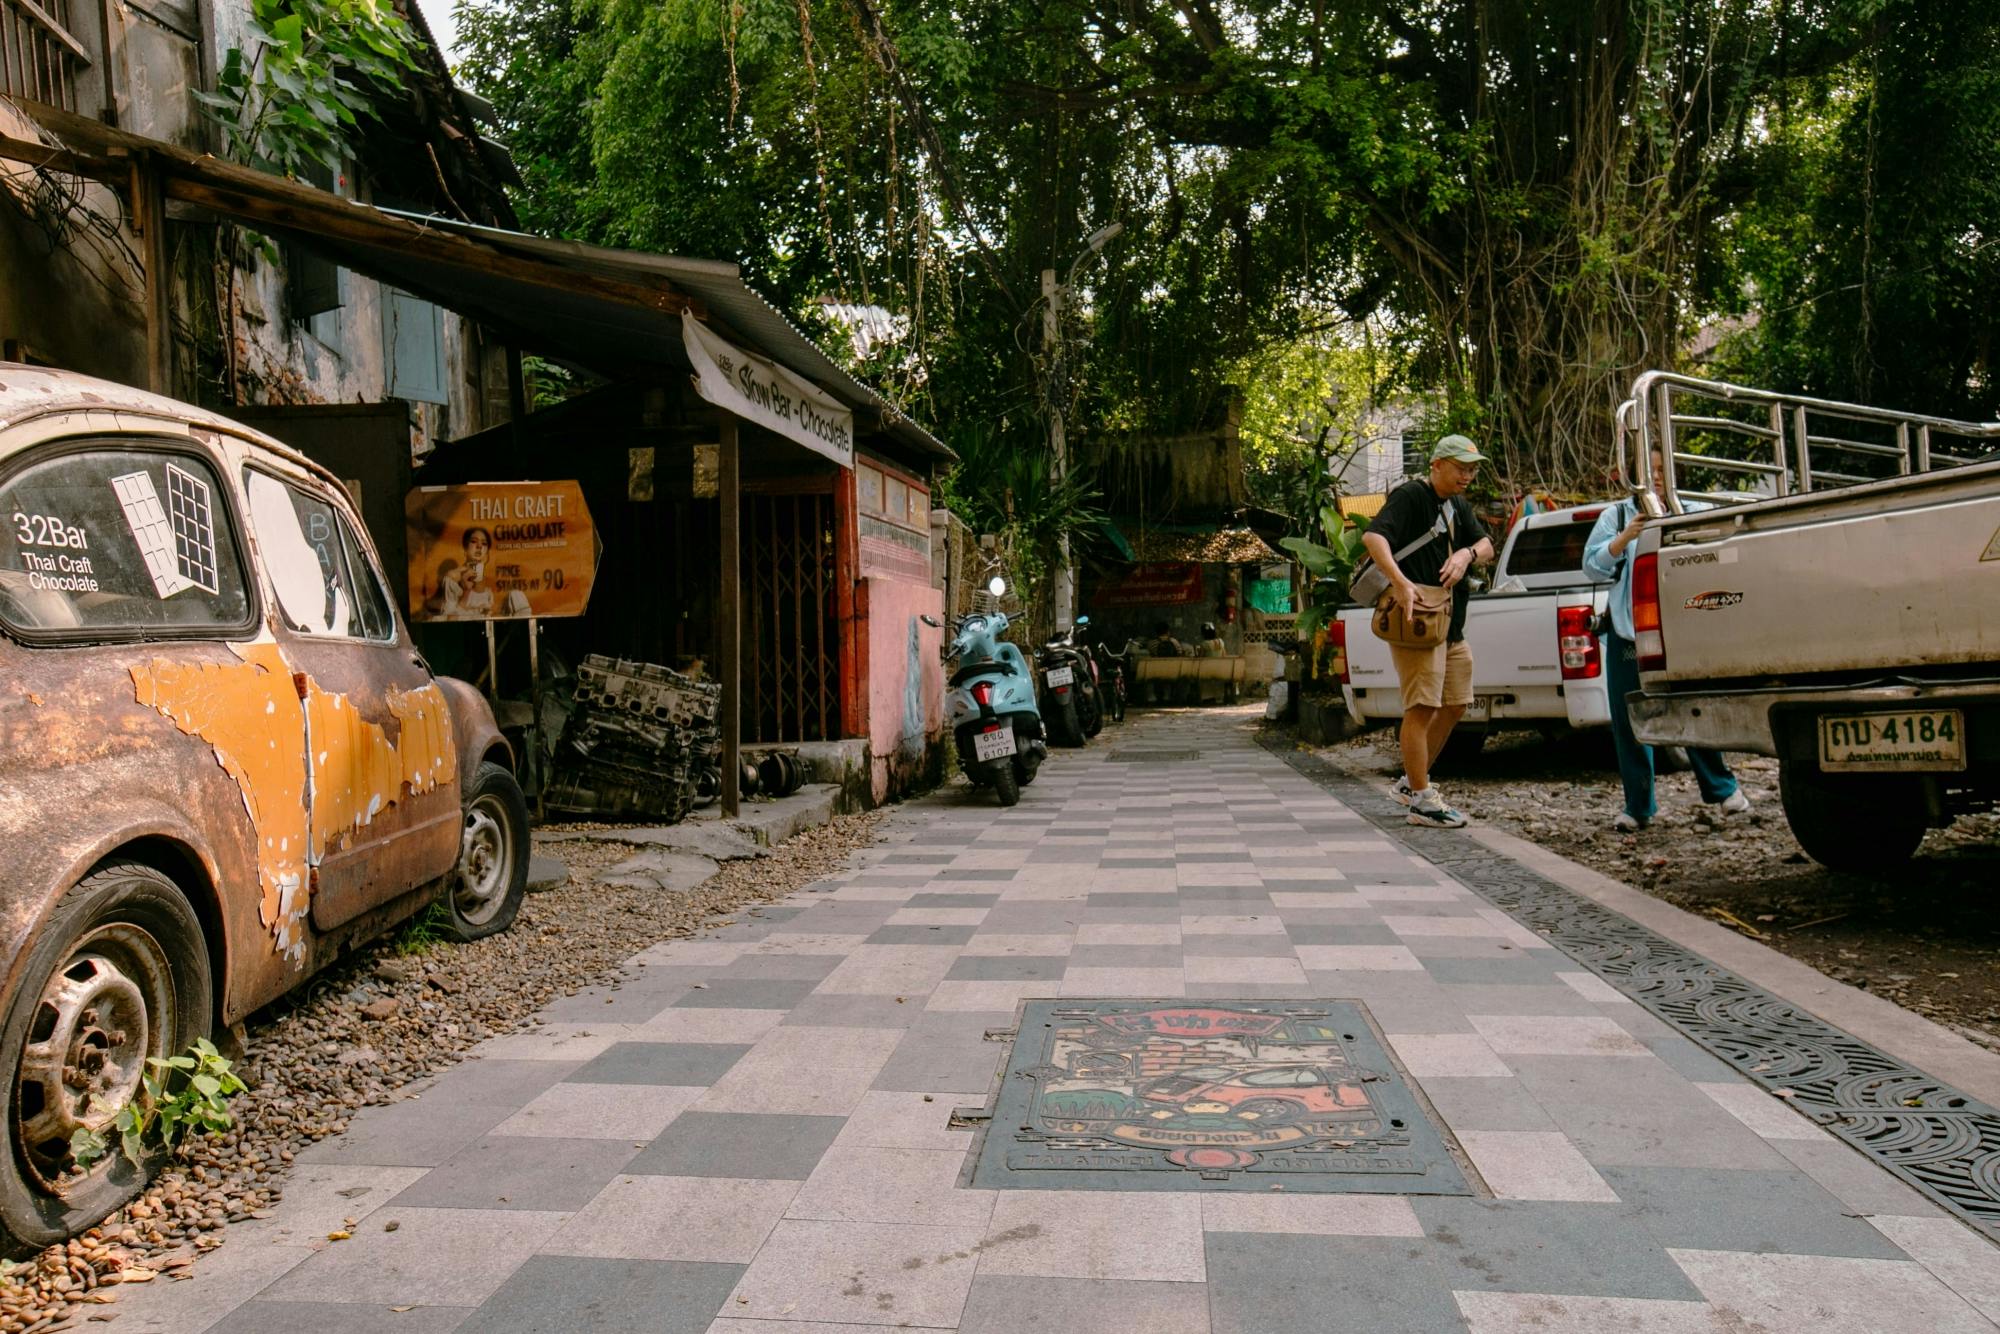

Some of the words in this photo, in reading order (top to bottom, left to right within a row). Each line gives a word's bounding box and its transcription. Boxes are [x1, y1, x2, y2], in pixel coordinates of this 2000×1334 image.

[739, 363, 770, 411] Slow
[771, 381, 791, 421] Bar
[800, 400, 849, 453] Chocolate
[470, 498, 508, 520] THAI
[514, 495, 565, 518] CRAFT
[13, 512, 88, 550] 32Bar
[493, 522, 566, 541] CHOCOLATE
[22, 552, 56, 572] Thai
[58, 555, 93, 575] Craft
[1669, 552, 1719, 567] TOYOTA
[30, 572, 99, 592] Chocolate
[1882, 714, 1956, 744] 4184
[984, 746, 1010, 760] 6107
